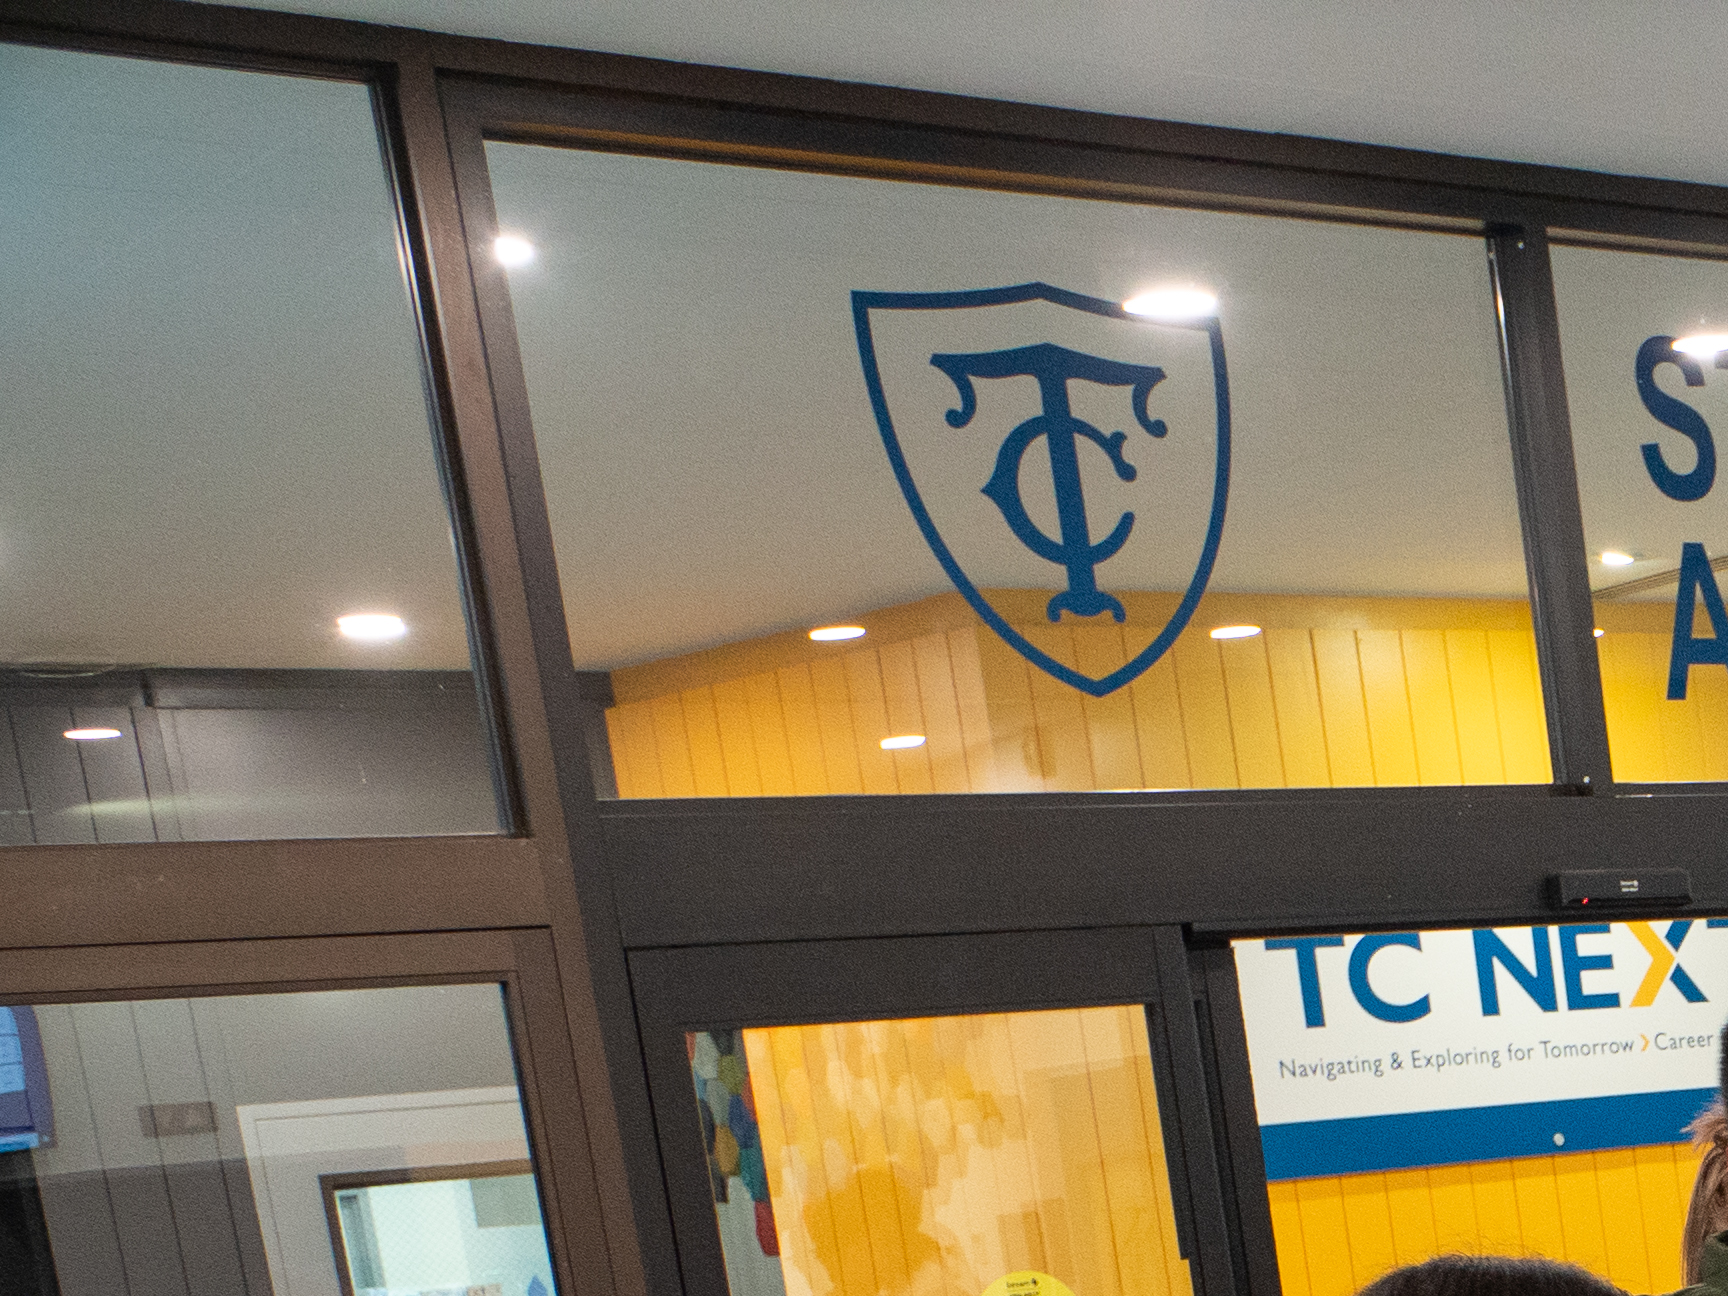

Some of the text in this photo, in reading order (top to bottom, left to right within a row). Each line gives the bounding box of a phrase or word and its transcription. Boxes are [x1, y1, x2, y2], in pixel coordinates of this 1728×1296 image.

[1264, 933, 1432, 1029] TC
[1278, 1032, 1713, 1081] Navigating & Exploring for Tomorrow Career
